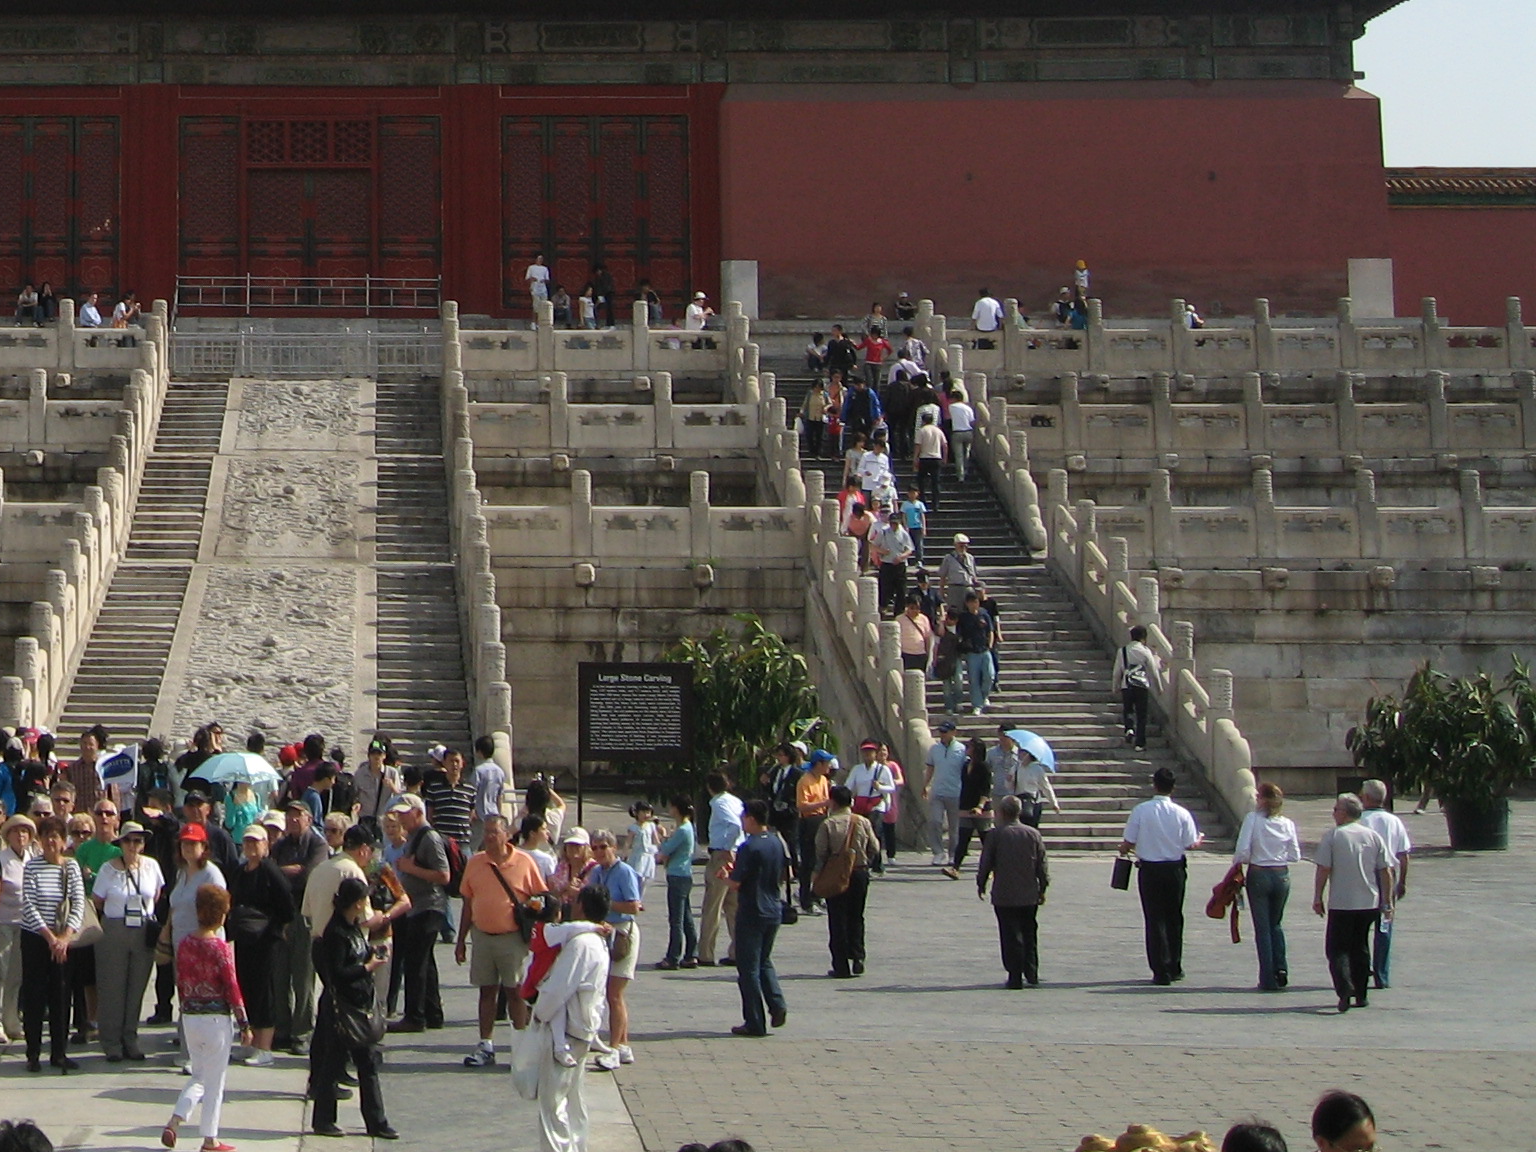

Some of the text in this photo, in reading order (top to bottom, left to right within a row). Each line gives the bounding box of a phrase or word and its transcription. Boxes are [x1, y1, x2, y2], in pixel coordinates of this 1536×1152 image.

[598, 674, 672, 683] Large Stone Carving
